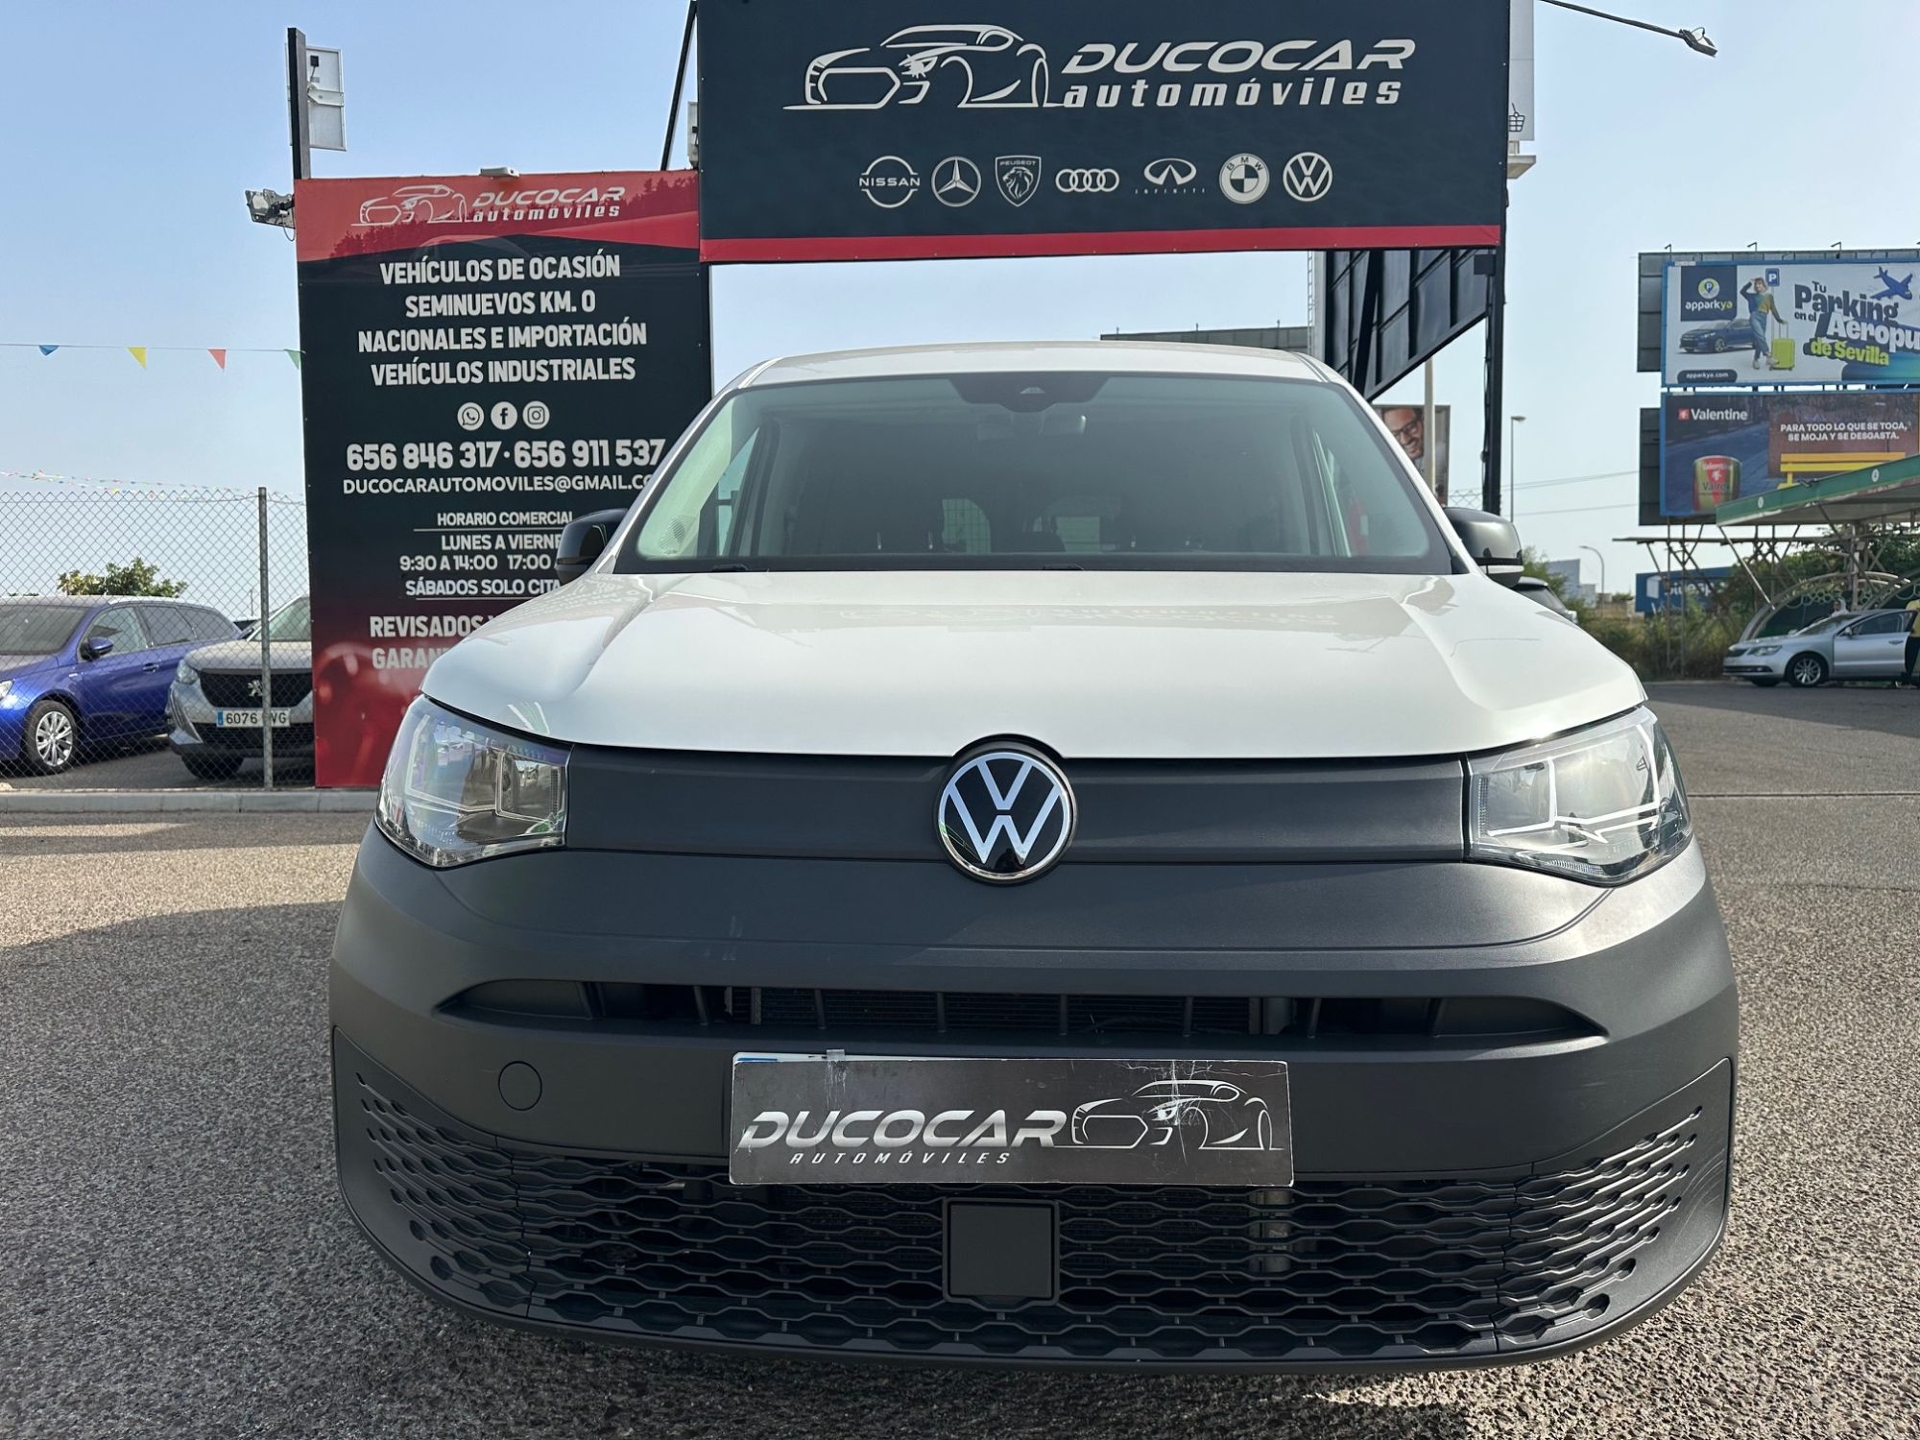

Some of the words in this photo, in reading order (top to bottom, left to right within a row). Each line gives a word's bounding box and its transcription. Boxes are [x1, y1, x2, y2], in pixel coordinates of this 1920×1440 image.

[1061, 39, 1416, 74] DUCOCAR
[1062, 77, 1402, 108] automóviles
[1226, 156, 1264, 172] BMW
[859, 177, 921, 187] NISSAN
[472, 186, 626, 208] DUCOCAR
[379, 256, 493, 285] VEHÍCULOS
[498, 258, 525, 281] DE
[529, 249, 620, 279] OCASIÓN
[1811, 281, 1827, 293] Tu
[405, 291, 536, 318] SEMINUEVOS
[540, 290, 577, 314] KM.
[1685, 299, 1733, 311] apparkya
[1794, 284, 1899, 326] Parking
[1794, 311, 1807, 320] en
[1808, 312, 1817, 322] el
[358, 327, 487, 353] NACIONALES
[491, 326, 504, 349] E
[508, 316, 648, 348] IMPORTACIÓN
[1811, 337, 1832, 356] de
[1834, 340, 1890, 366] Sevilla
[370, 356, 484, 386] VEHÍCULOS
[488, 357, 637, 384] INDUSTRIALES
[1690, 408, 1748, 421] Valentine
[1780, 423, 1805, 432] PARA
[1806, 423, 1833, 431] TODO
[1834, 423, 1846, 431] LO
[1847, 422, 1866, 431] QUE
[1867, 422, 1879, 430] SE
[1880, 422, 1908, 431] TOCA,
[1788, 433, 1800, 441] SE
[1801, 432, 1828, 441] MOJA
[1829, 432, 1836, 440] Y
[1837, 432, 1849, 440] SE
[1850, 431, 1900, 440] DESGASTA.
[346, 442, 398, 471] 656
[402, 441, 454, 470] 846
[571, 438, 610, 468] 911
[615, 438, 667, 467] 537
[437, 511, 497, 526] HORARIO
[441, 534, 492, 550] LUNES
[495, 534, 506, 550] A
[399, 555, 437, 571] 9:30
[440, 555, 451, 571] A
[453, 554, 498, 570] 14:00
[507, 554, 552, 570] 17:00
[405, 576, 478, 596] SÁBADOS
[481, 579, 525, 595] SOLO
[225, 712, 258, 724] 6076
[737, 1109, 1068, 1149] DUCOCAR
[790, 1150, 1011, 1165] AUTOMÓVILES
